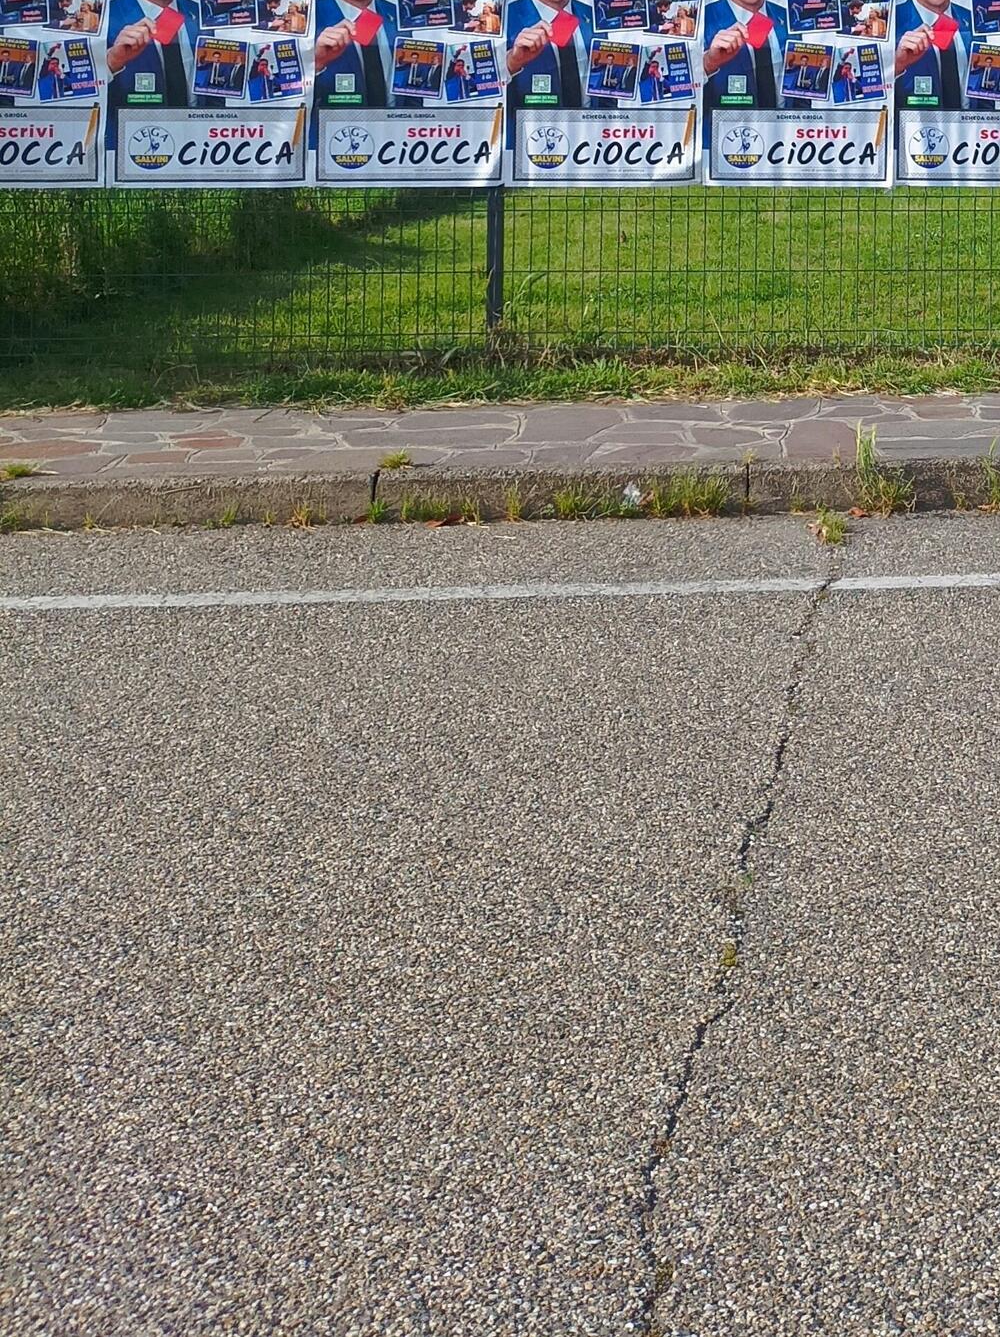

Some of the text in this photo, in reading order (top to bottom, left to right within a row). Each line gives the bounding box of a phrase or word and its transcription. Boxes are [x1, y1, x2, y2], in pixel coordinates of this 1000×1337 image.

[0, 125, 54, 138] scrivi
[132, 129, 168, 143] LEGA
[209, 125, 264, 138] scrivi
[333, 129, 368, 143] LEGA
[408, 125, 461, 138] scrivi
[530, 129, 564, 143] LEGA
[602, 126, 655, 139] scrivi
[726, 129, 759, 143] LEGA
[796, 126, 848, 139] scrivi
[912, 130, 944, 143] LEGA
[134, 155, 169, 164] SALVINI
[335, 155, 369, 164] SALVINI
[531, 155, 564, 163] SALVINI
[727, 154, 759, 163] SALVINI
[913, 155, 945, 163] SALVINI
